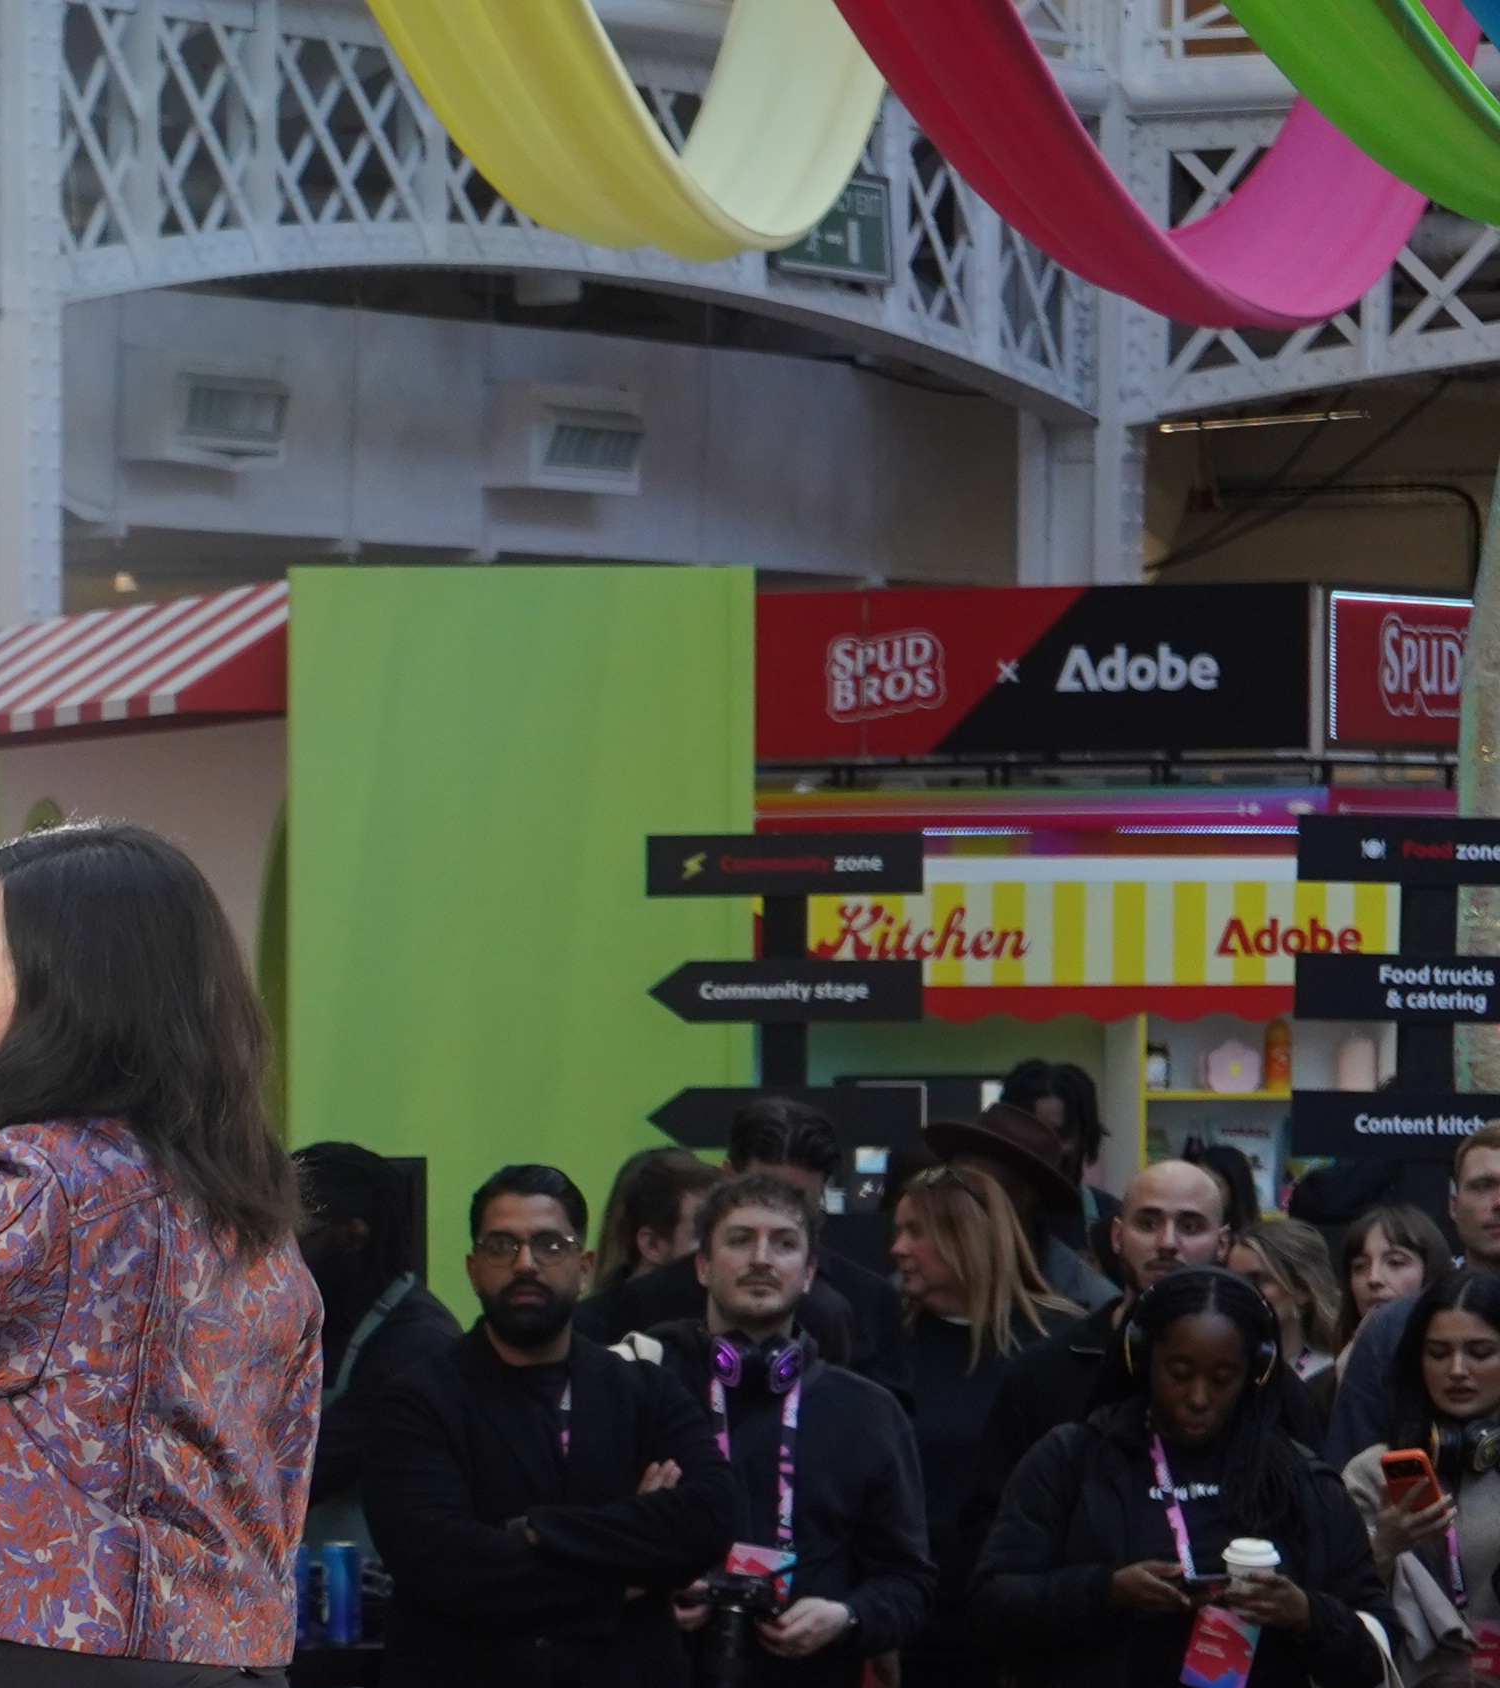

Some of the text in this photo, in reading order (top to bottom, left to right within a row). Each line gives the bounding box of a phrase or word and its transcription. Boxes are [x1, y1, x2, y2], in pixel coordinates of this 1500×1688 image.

[831, 637, 933, 681] SPUD
[1056, 643, 1220, 692] Adobe
[1383, 624, 1462, 696] SPUD
[832, 666, 936, 711] BROS
[834, 855, 884, 873] zone
[808, 903, 1363, 960] Kitchen Adobe
[700, 979, 870, 1004] Community stage
[1379, 964, 1495, 986] Food trucks
[1385, 988, 1488, 1013] & catering
[1354, 1112, 1484, 1137] Content kitch
